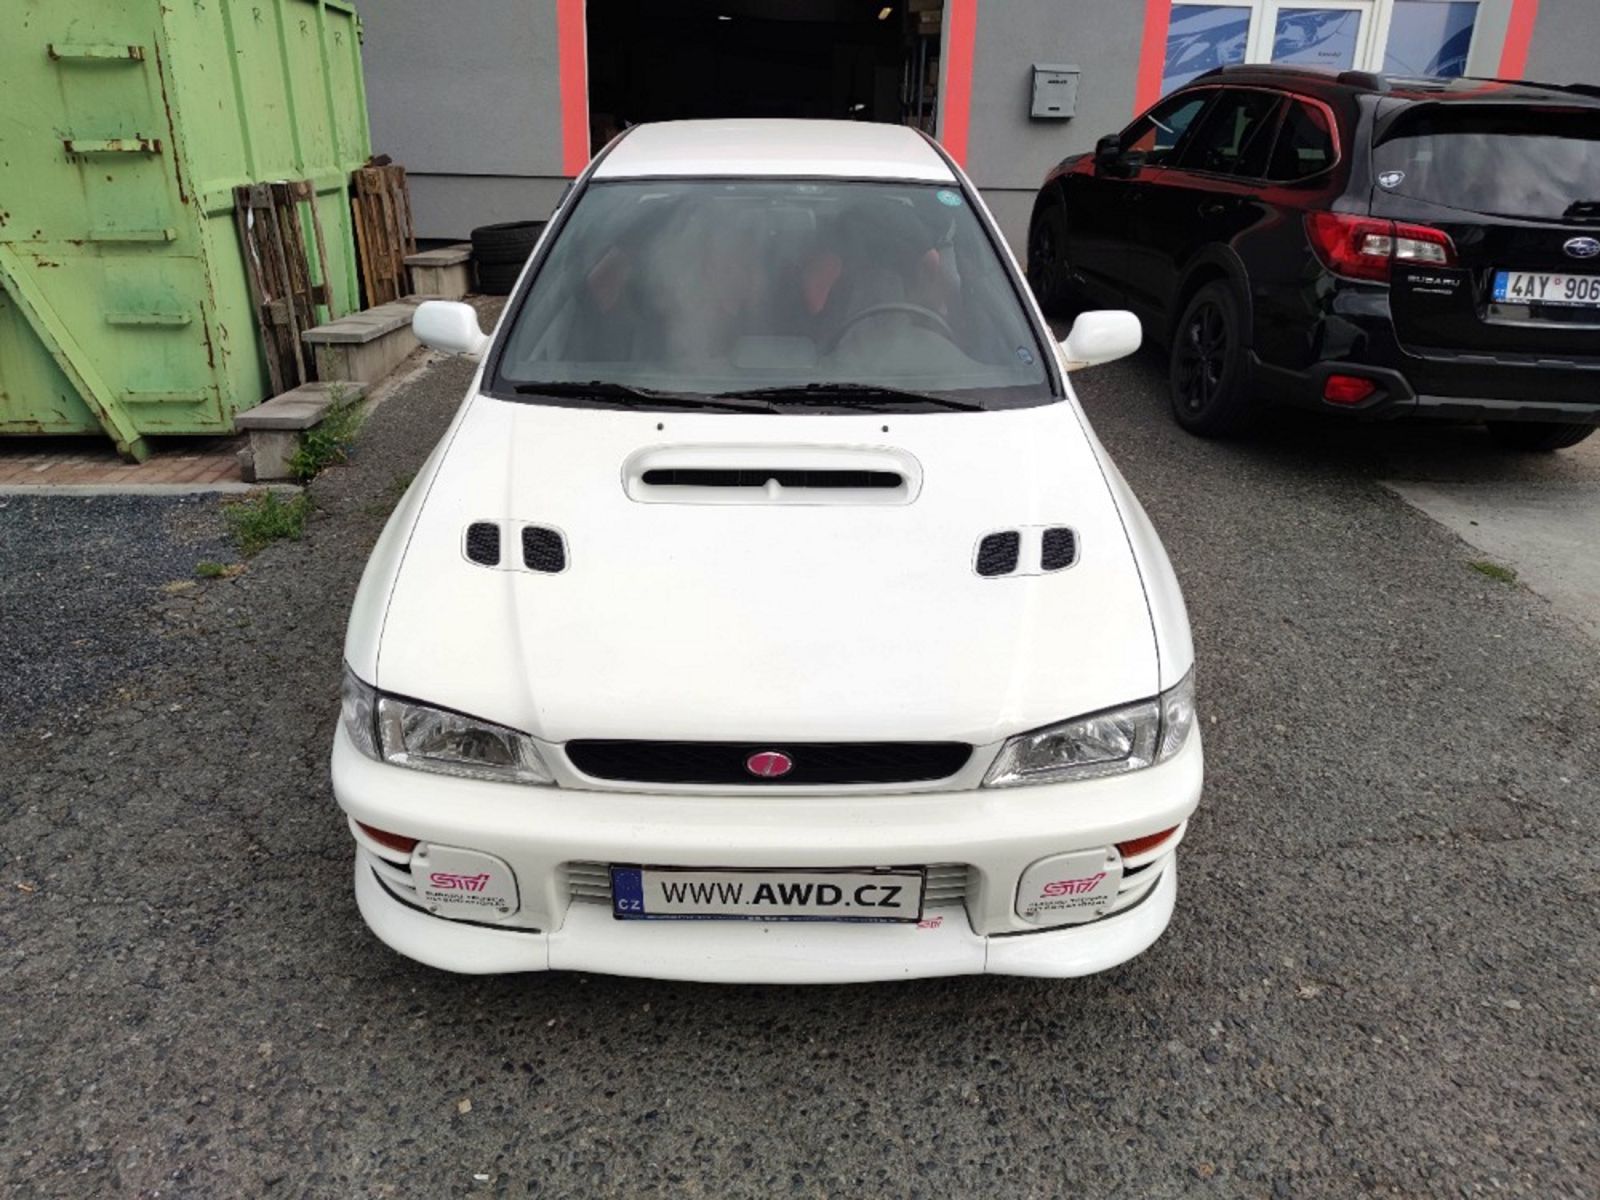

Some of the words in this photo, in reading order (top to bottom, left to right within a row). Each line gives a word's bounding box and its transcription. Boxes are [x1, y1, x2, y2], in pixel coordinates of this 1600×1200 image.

[1407, 275, 1460, 287] SUBARU
[1511, 274, 1550, 298] 4AY
[661, 881, 903, 907] WWW.AWD.CZ
[618, 898, 641, 910] CZ
